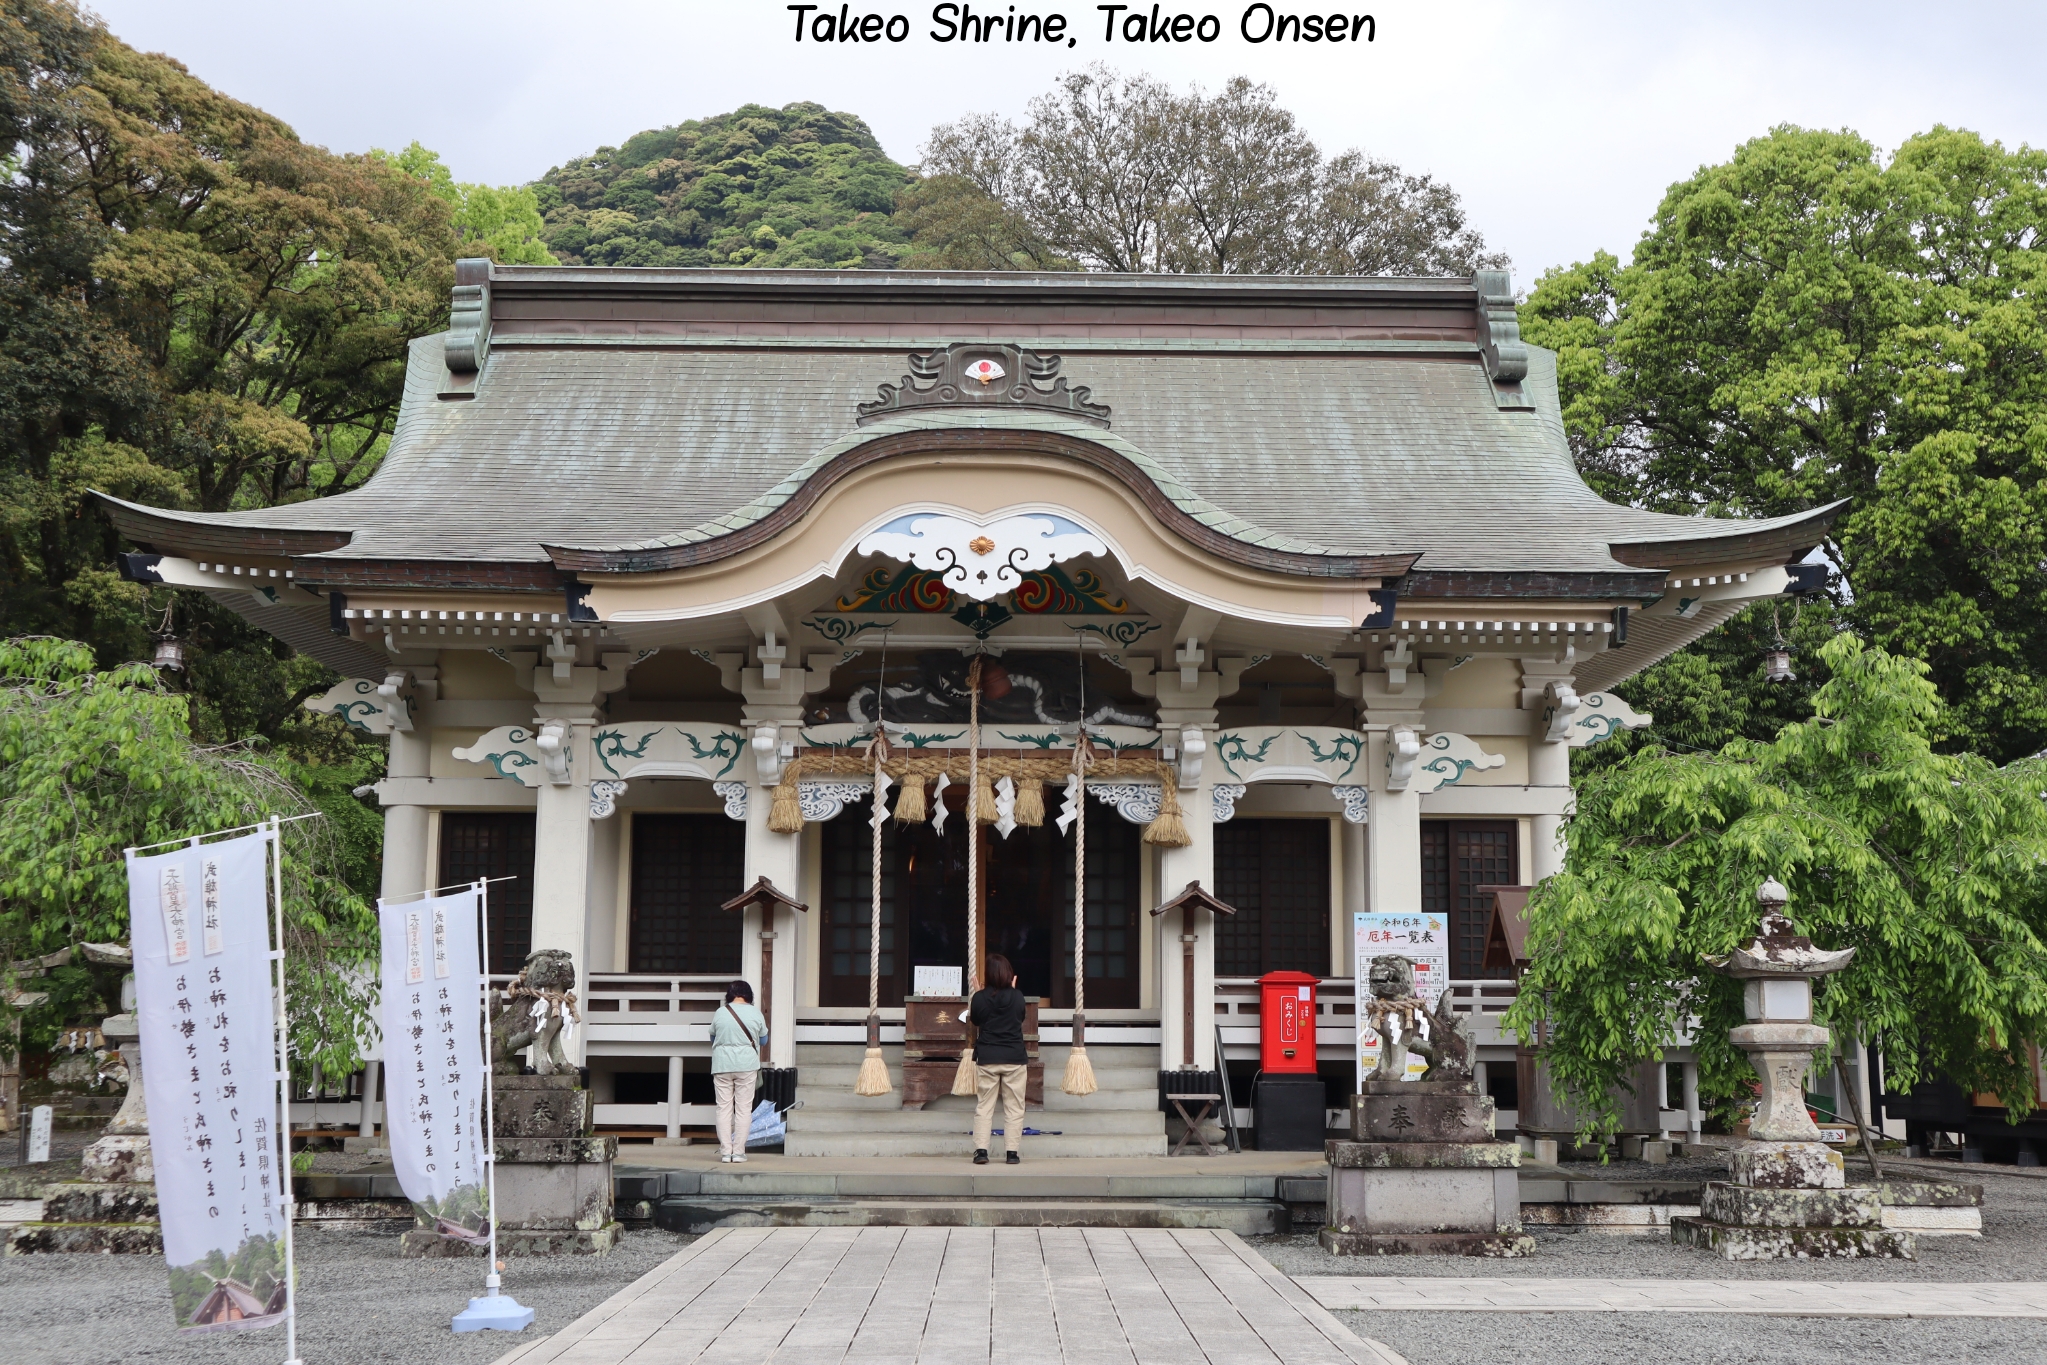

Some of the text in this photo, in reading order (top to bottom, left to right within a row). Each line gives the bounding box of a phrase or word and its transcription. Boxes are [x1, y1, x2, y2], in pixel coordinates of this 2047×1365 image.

[1381, 917, 1422, 928] 令和6年
[1367, 930, 1435, 944] 厄年一覧表
[1285, 1002, 1293, 1037] おみくじ
